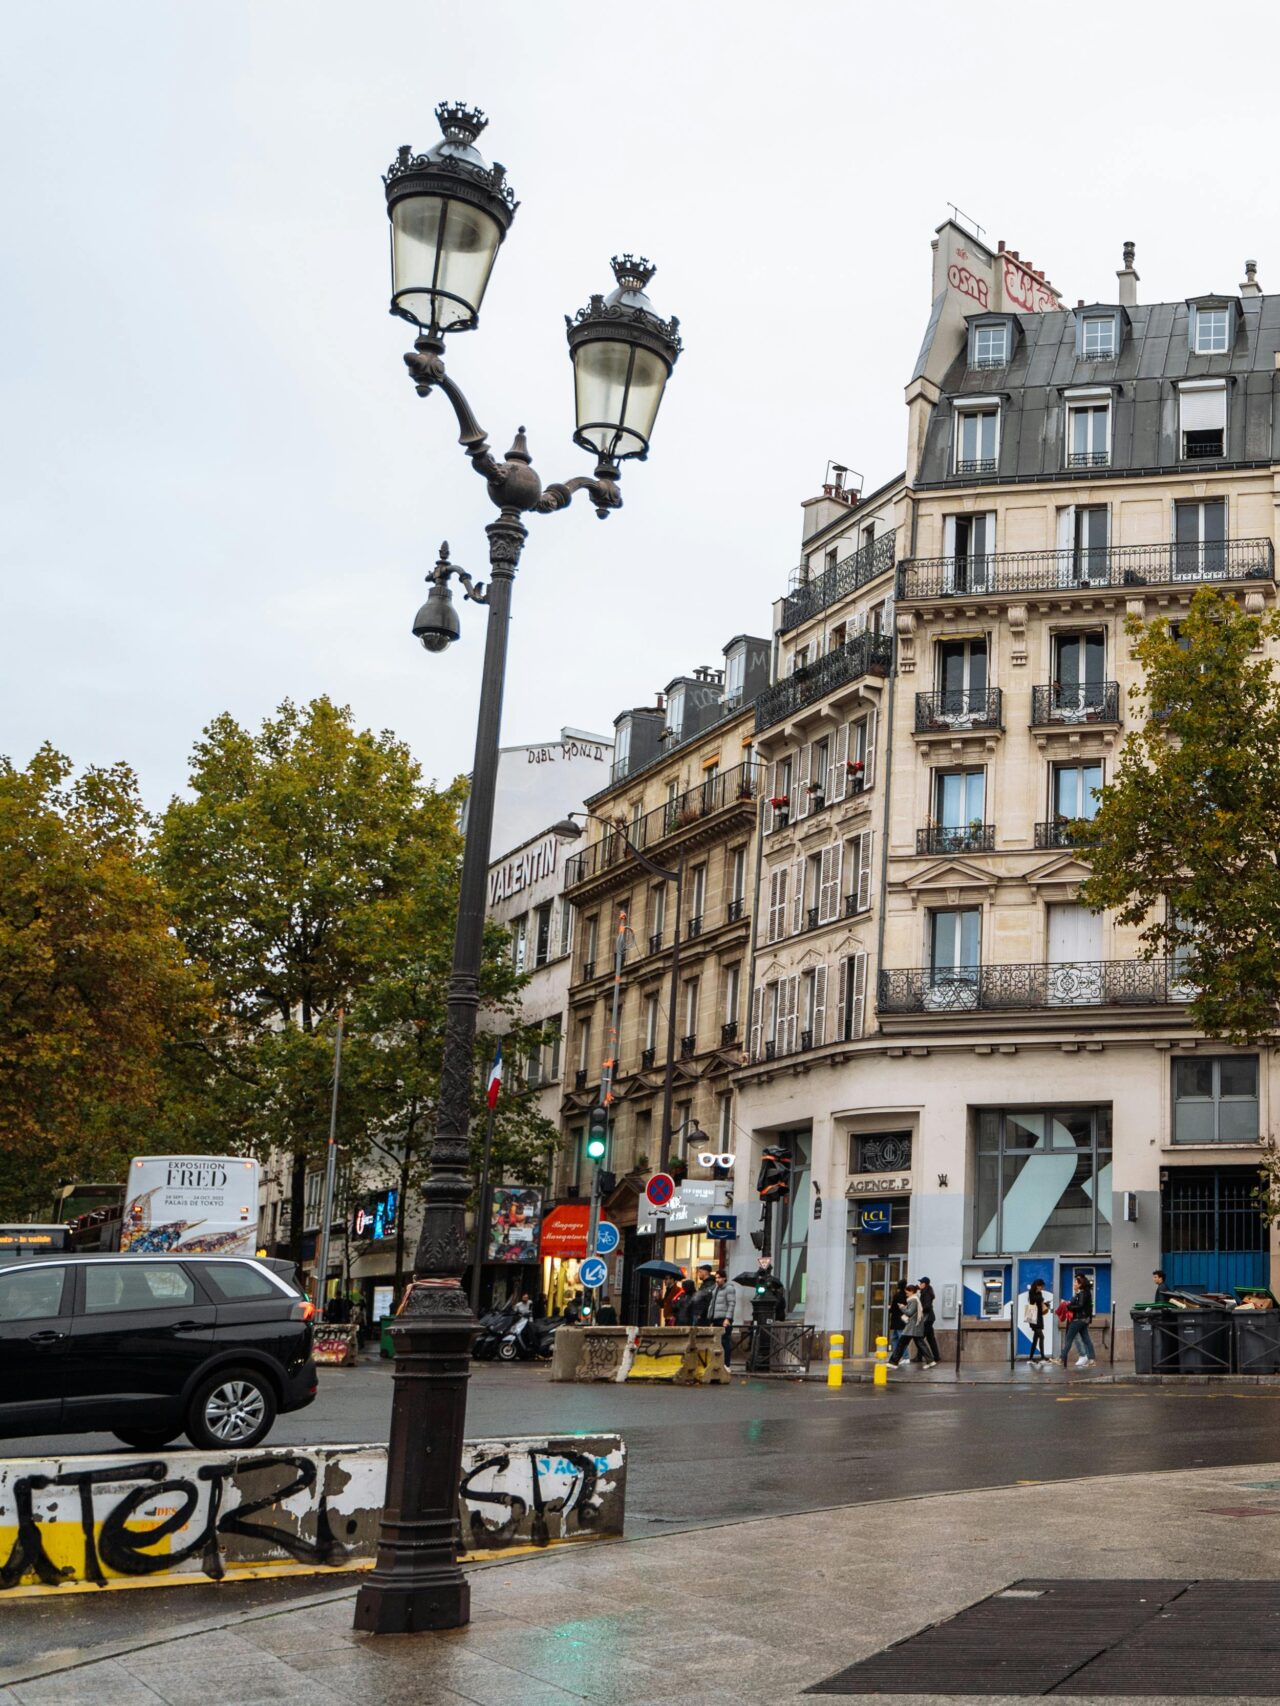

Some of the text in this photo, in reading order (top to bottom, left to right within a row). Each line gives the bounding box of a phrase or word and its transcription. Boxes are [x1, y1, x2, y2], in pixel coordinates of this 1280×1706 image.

[488, 839, 559, 907] VALENTIN
[168, 1162, 225, 1170] EXPOSITION
[166, 1170, 227, 1186] FRED
[863, 1210, 887, 1221] LCL
[709, 1220, 733, 1230] LCL
